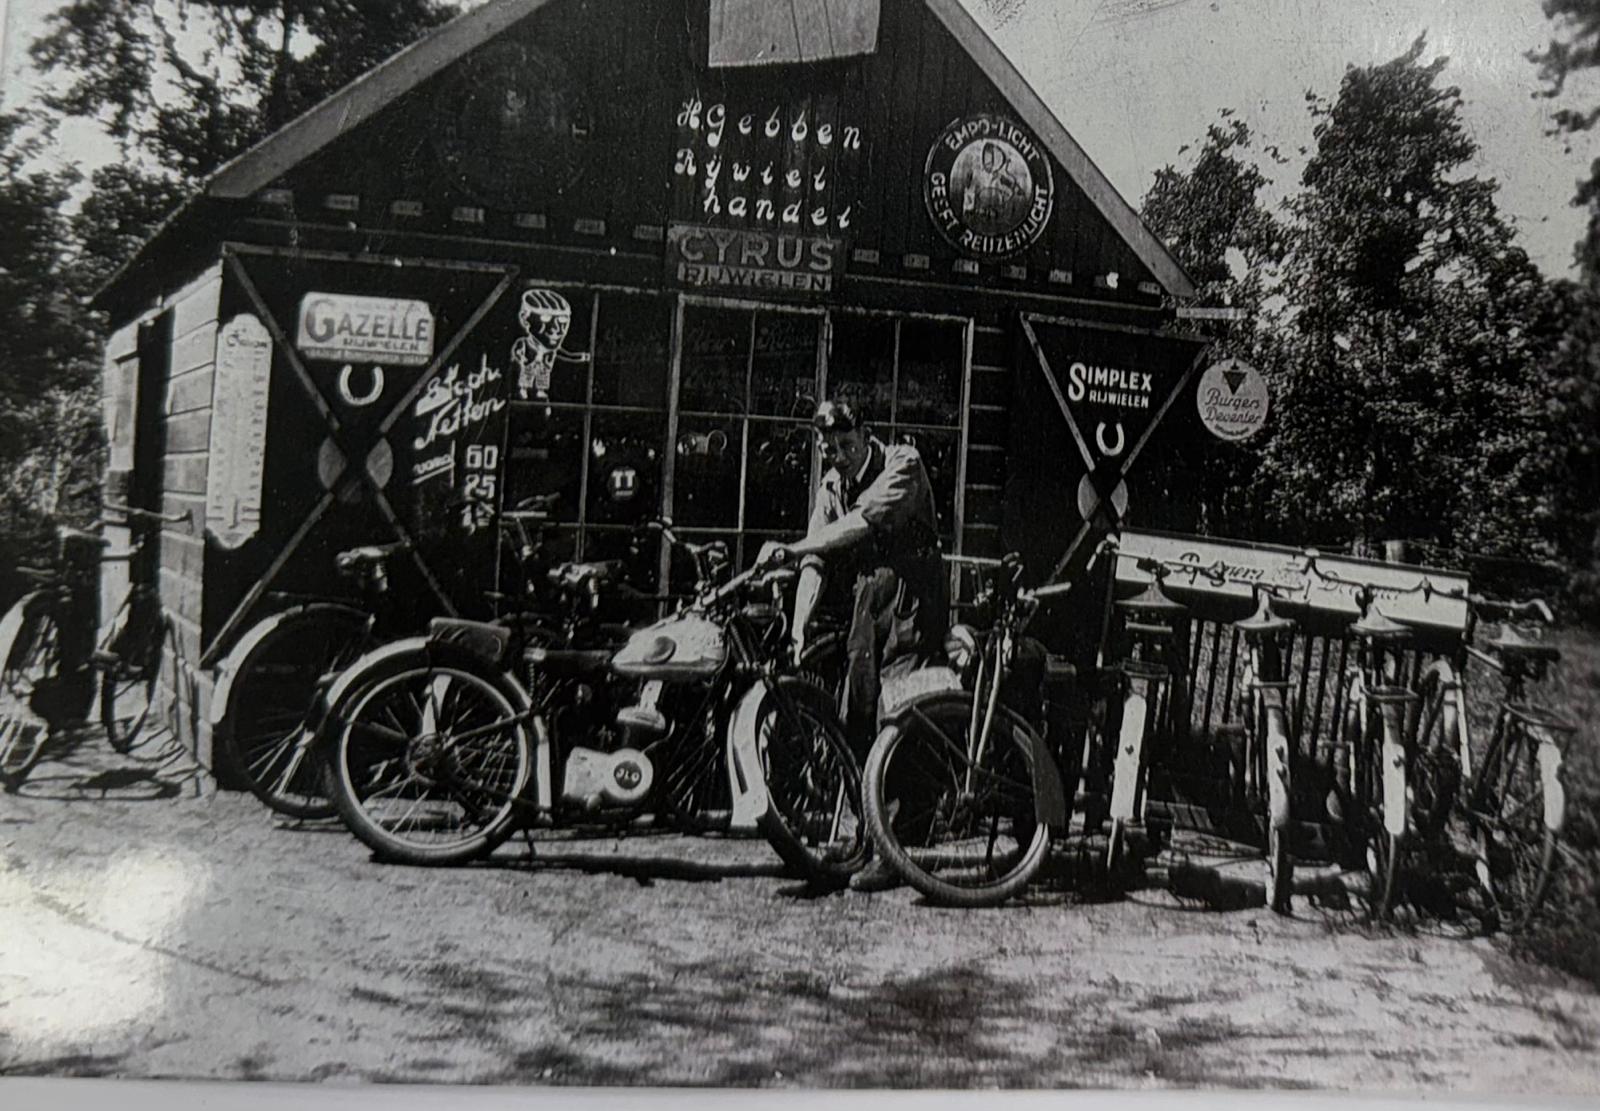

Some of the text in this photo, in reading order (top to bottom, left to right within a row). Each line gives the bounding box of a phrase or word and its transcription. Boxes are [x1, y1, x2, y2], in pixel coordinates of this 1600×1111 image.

[944, 118, 1040, 162] EMPO-LICHT
[703, 187, 851, 229] handel
[680, 229, 835, 272] CYRUS
[305, 299, 430, 343] GAZELLE
[1068, 362, 1152, 402] SIMPLEX
[1089, 389, 1149, 409] RIJWIELEN
[1205, 387, 1260, 411] Burgers
[466, 444, 499, 470] 60
